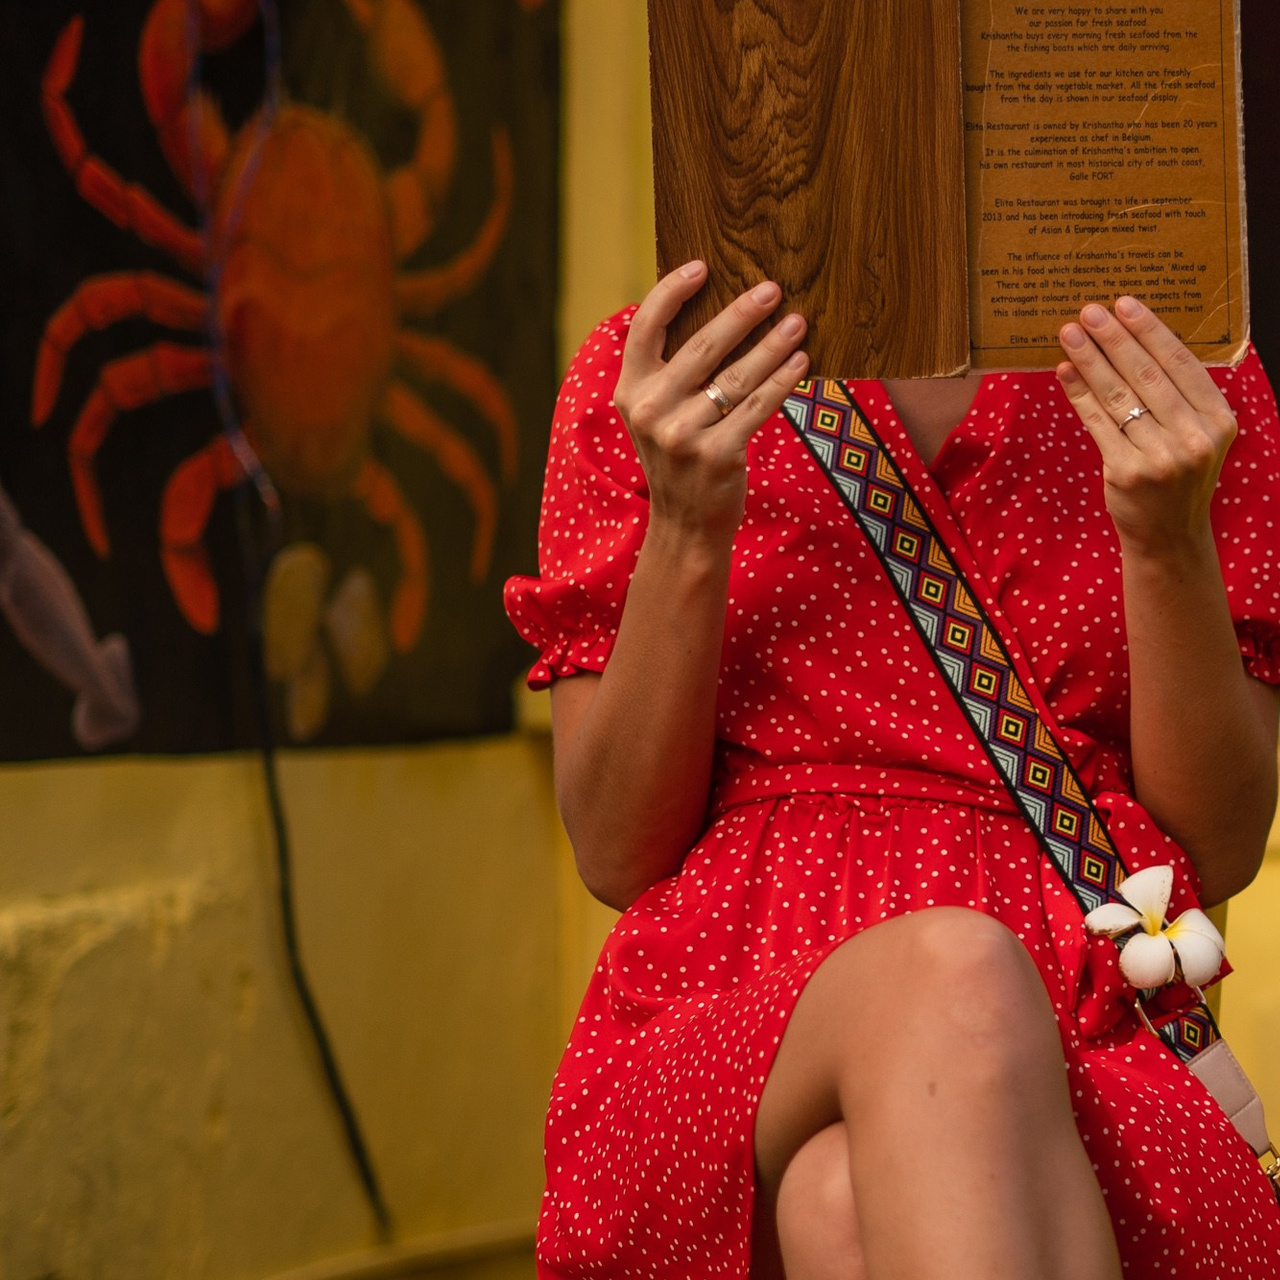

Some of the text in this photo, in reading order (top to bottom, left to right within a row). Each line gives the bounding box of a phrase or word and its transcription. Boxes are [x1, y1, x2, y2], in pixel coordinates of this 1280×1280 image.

[1047, 8, 1065, 17] very
[1068, 6, 1091, 17] happy
[1105, 6, 1127, 15] share
[1129, 6, 1147, 15] with
[1149, 8, 1163, 17] you
[1044, 19, 1073, 30] passion
[1075, 18, 1088, 27] for
[1091, 18, 1113, 27] fresh
[1025, 31, 1044, 42] buys
[1046, 33, 1069, 42] every
[1071, 31, 1101, 42] morning
[1104, 30, 1126, 39] fresh
[1129, 30, 1160, 39] seafood
[1162, 30, 1182, 39] from
[1184, 30, 1198, 39] the
[1006, 43, 1020, 52] the
[1023, 43, 1050, 54] fishing
[1052, 43, 1074, 52] boats
[1077, 43, 1099, 52] which
[1117, 43, 1137, 54] daily
[988, 70, 1005, 79] The
[1008, 69, 1051, 80] ingredients
[1084, 69, 1097, 78] for
[1115, 68, 1144, 78] kitchen
[1161, 68, 1191, 79] freshly
[995, 82, 1014, 91] from
[1017, 82, 1030, 91] the
[1033, 82, 1052, 93] daily
[1055, 81, 1093, 93] vegetable
[1130, 81, 1141, 90] All
[1143, 80, 1157, 90] the
[1160, 80, 1182, 89] fresh
[1184, 80, 1215, 89] seafood
[1000, 95, 1019, 104] from
[1022, 94, 1036, 104] the
[1039, 94, 1053, 105] day
[1066, 94, 1089, 103] shown
[1117, 93, 1148, 102] seafood
[986, 122, 1030, 131] Restaurant
[1042, 121, 1067, 130] owned
[1144, 120, 1158, 129] has
[1161, 119, 1180, 129] been
[1195, 121, 1218, 130] years
[1090, 133, 1109, 143] chef
[1007, 147, 1021, 156] the
[1133, 145, 1167, 155] ambition
[1180, 147, 1199, 156] open
[979, 161, 991, 170] his
[1011, 161, 1053, 169] restaurant
[1066, 160, 1085, 169] most
[1088, 159, 1124, 168] historical
[1126, 159, 1143, 170] city
[1157, 158, 1178, 167] south
[1069, 171, 1114, 181] Galle FORT
[994, 199, 1014, 208] Elita
[1016, 198, 1060, 207] Restaurant
[1080, 197, 1110, 208] brought
[1125, 197, 1138, 206] life
[1151, 196, 1192, 207] september
[982, 209, 1206, 222] 2013 and has been introducing seafood with touch
[1040, 225, 1062, 234] Asian
[1074, 225, 1109, 236] European
[1111, 224, 1135, 233] mixed
[1006, 252, 1022, 261] The
[1025, 251, 1060, 260] influence
[1127, 249, 1155, 259] travels
[1012, 267, 1024, 276] his
[1026, 266, 1045, 275] food
[1047, 266, 1070, 275] which
[995, 279, 1020, 289] There
[1039, 279, 1049, 288] all
[1052, 278, 1066, 288] the
[1102, 277, 1116, 287] the
[1118, 278, 1142, 288] spices
[1145, 277, 1159, 286] and
[1162, 276, 1175, 285] the
[1178, 276, 1196, 285] vivid
[991, 295, 1038, 305] extravagant
[1042, 293, 1069, 302] colours
[1084, 293, 1110, 301] cuisine
[1150, 292, 1180, 302] expects
[1183, 290, 1202, 300] from
[993, 304, 1204, 317] this islands rich twist
[1010, 334, 1049, 344] Elita with
